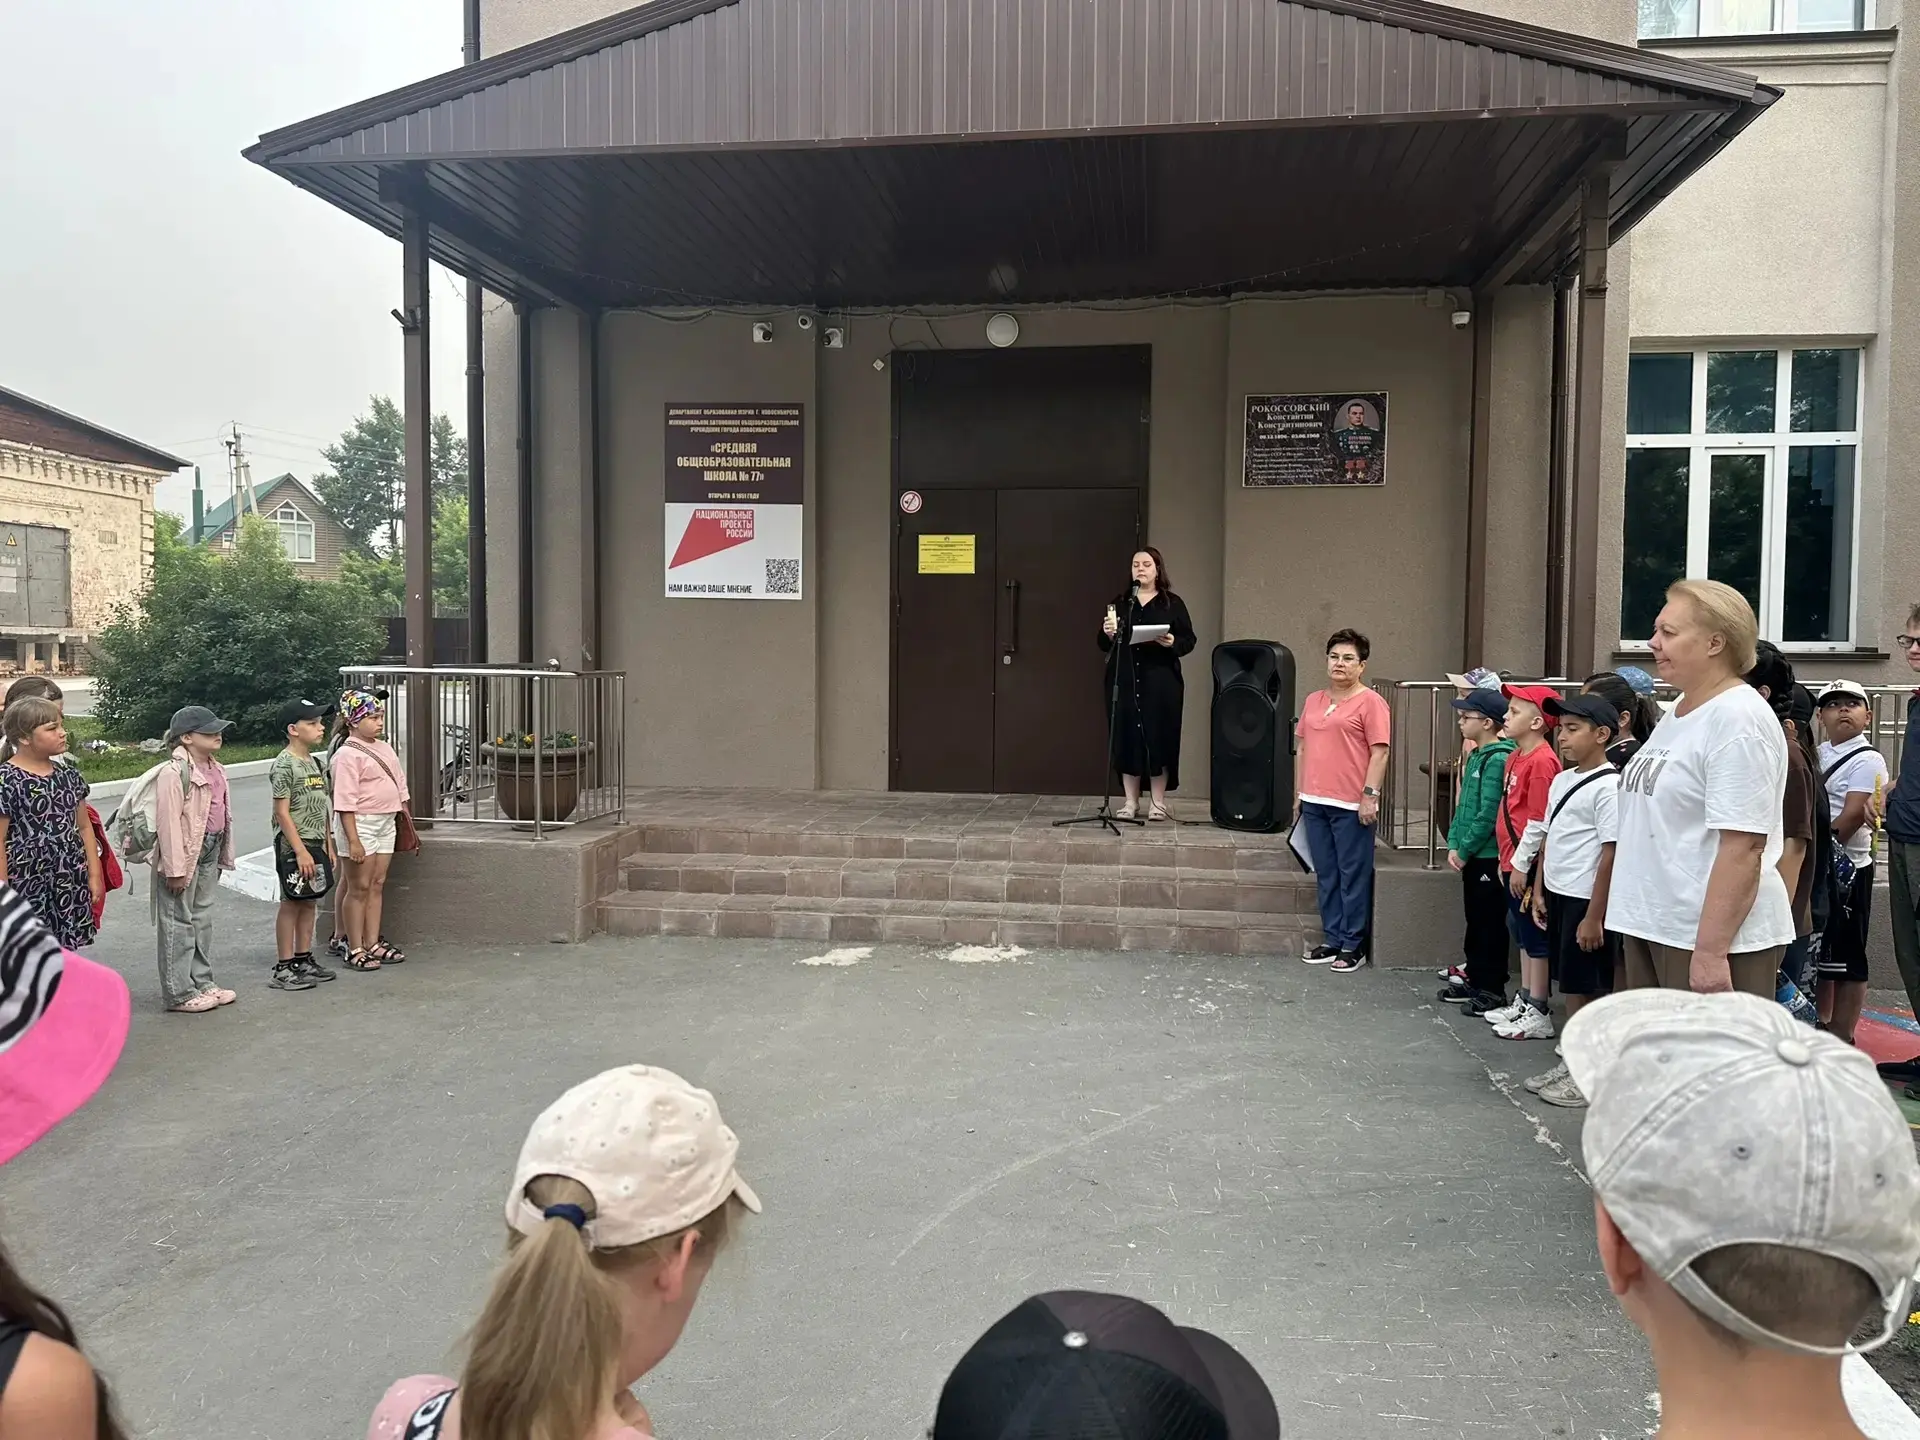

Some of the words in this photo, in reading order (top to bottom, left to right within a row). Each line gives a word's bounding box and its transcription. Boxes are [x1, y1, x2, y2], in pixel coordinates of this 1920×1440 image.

[1252, 402, 1330, 413] РОКОССОВСКИЙ
[1267, 413, 1314, 421] Константин
[1258, 421, 1323, 429] Константинович
[711, 443, 757, 454] «СРЕДНЯЯ
[677, 457, 791, 468] ОБЩЕОБРАЗОВАТЕЛЬНАЯ
[704, 471, 737, 481] ШКОЛА
[739, 471, 749, 481] №
[751, 471, 764, 481] 77»
[696, 510, 752, 520] НАЦИОНАЛЬНЫЕ
[720, 520, 752, 529] ПРОЕКТЫ
[726, 529, 752, 538] РОССИИ
[669, 584, 682, 593] НАМ
[684, 584, 706, 593] ВАЖНО
[708, 585, 725, 593] ВАШЕ
[727, 585, 752, 594] МНЕНИЕ
